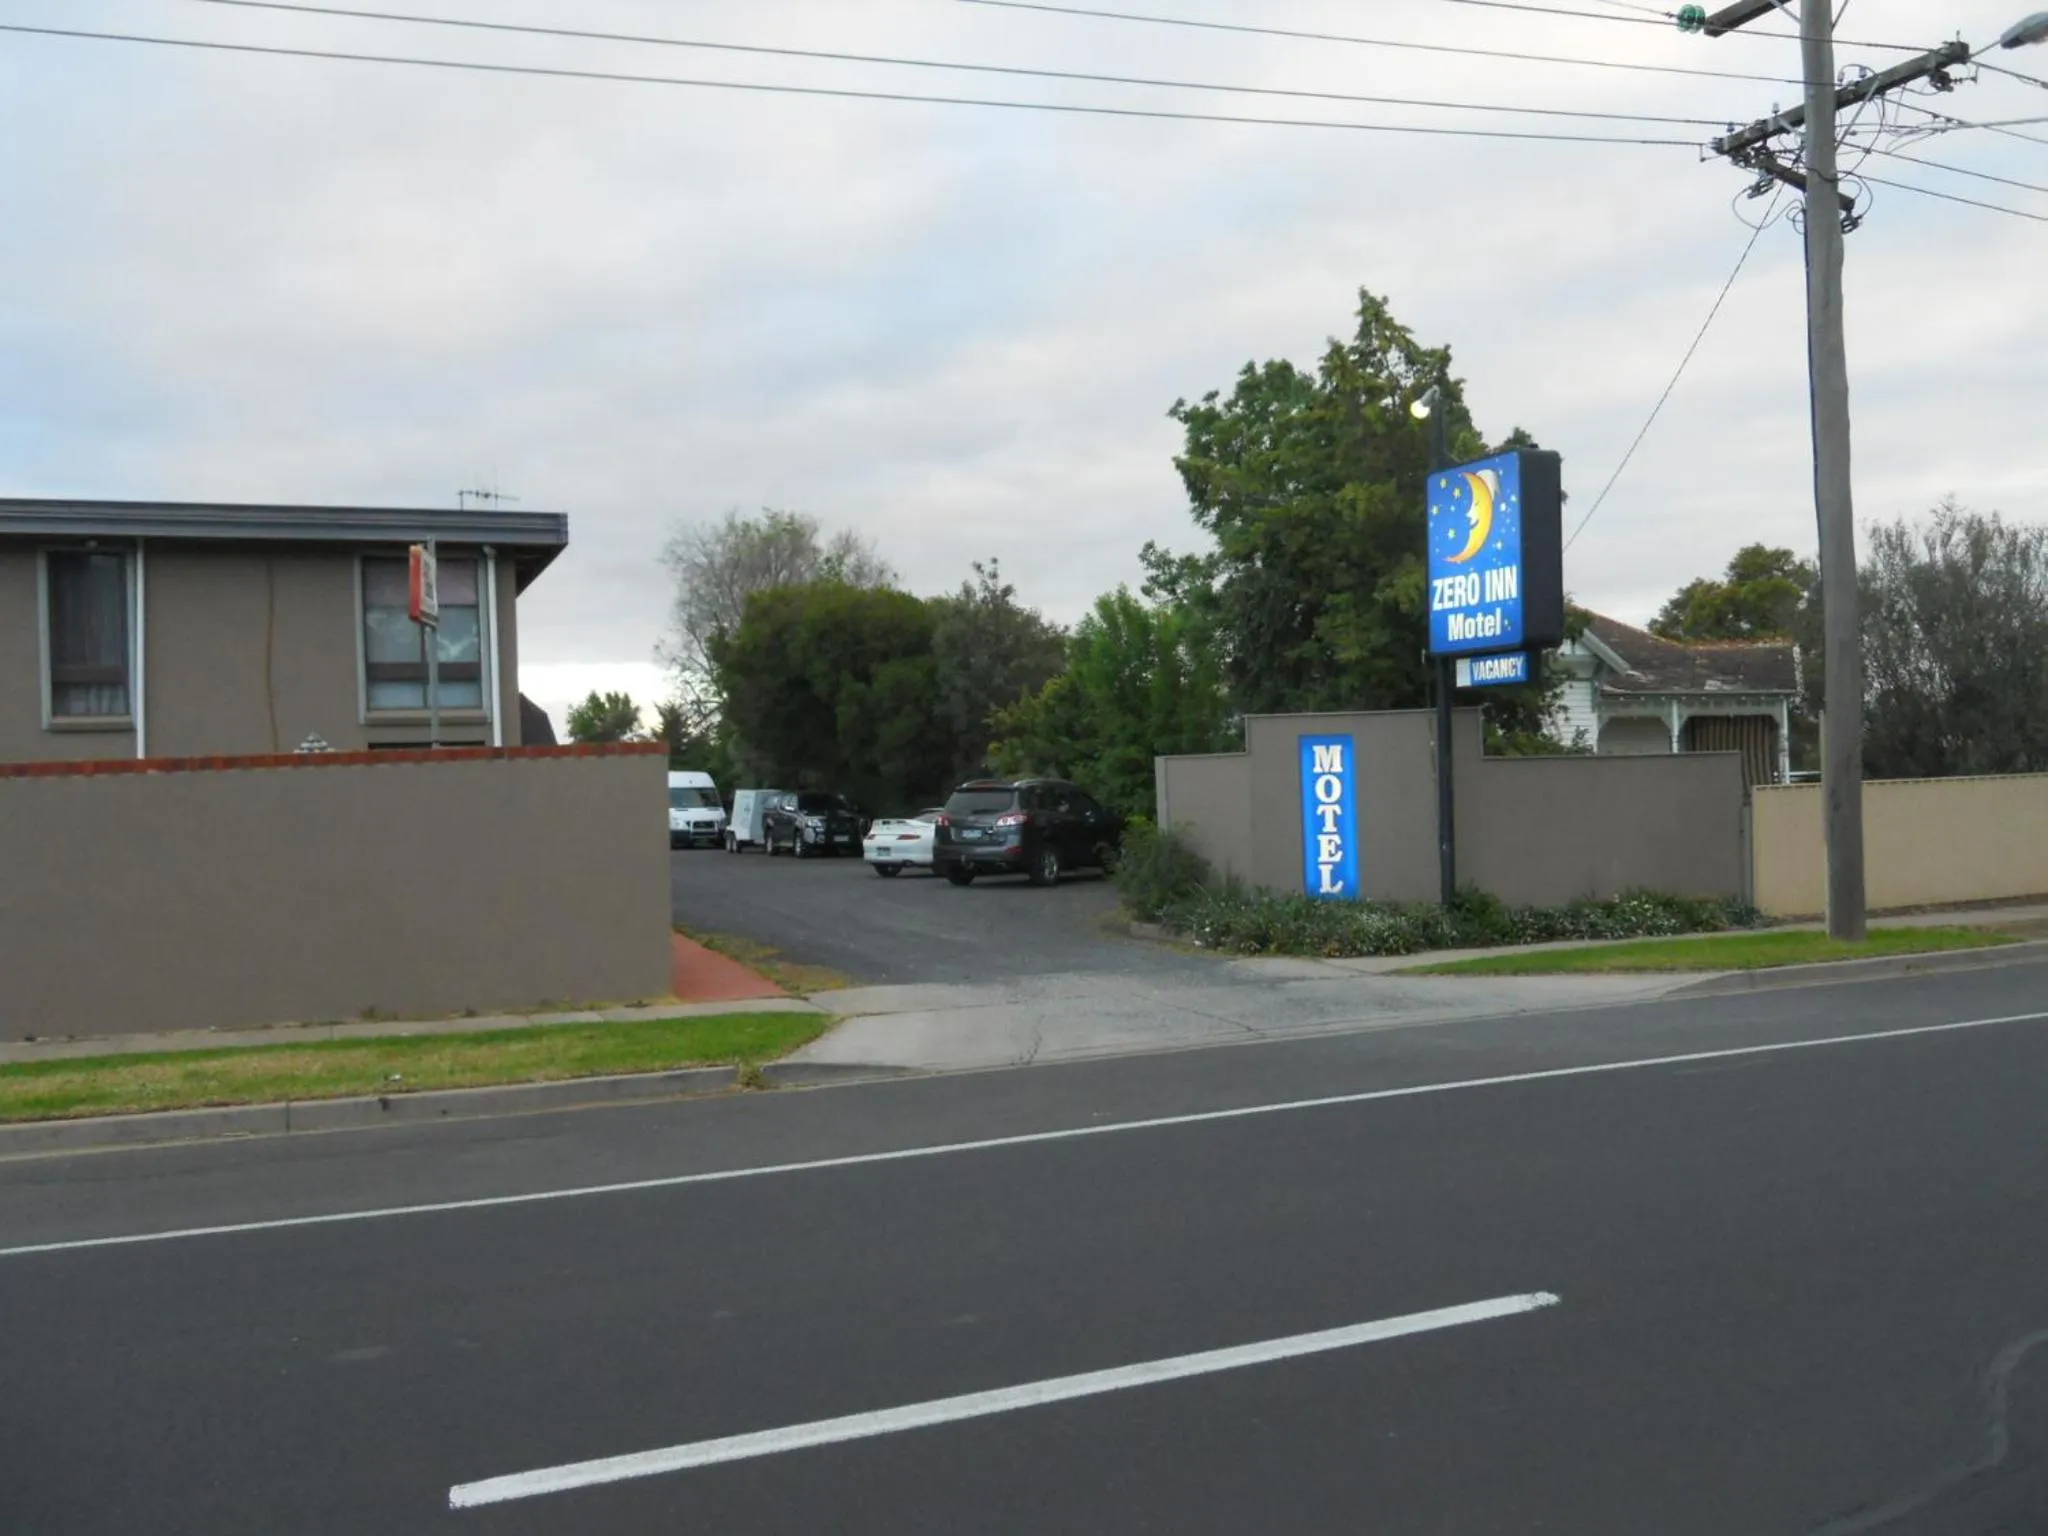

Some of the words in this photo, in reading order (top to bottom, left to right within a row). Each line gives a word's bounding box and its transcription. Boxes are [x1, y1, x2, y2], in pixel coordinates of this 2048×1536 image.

[1432, 572, 1480, 611] ZERO
[1485, 565, 1517, 603] INN
[1448, 607, 1501, 641] Motel
[1471, 655, 1524, 681] VACANCY
[1312, 744, 1344, 894] MOTEL
